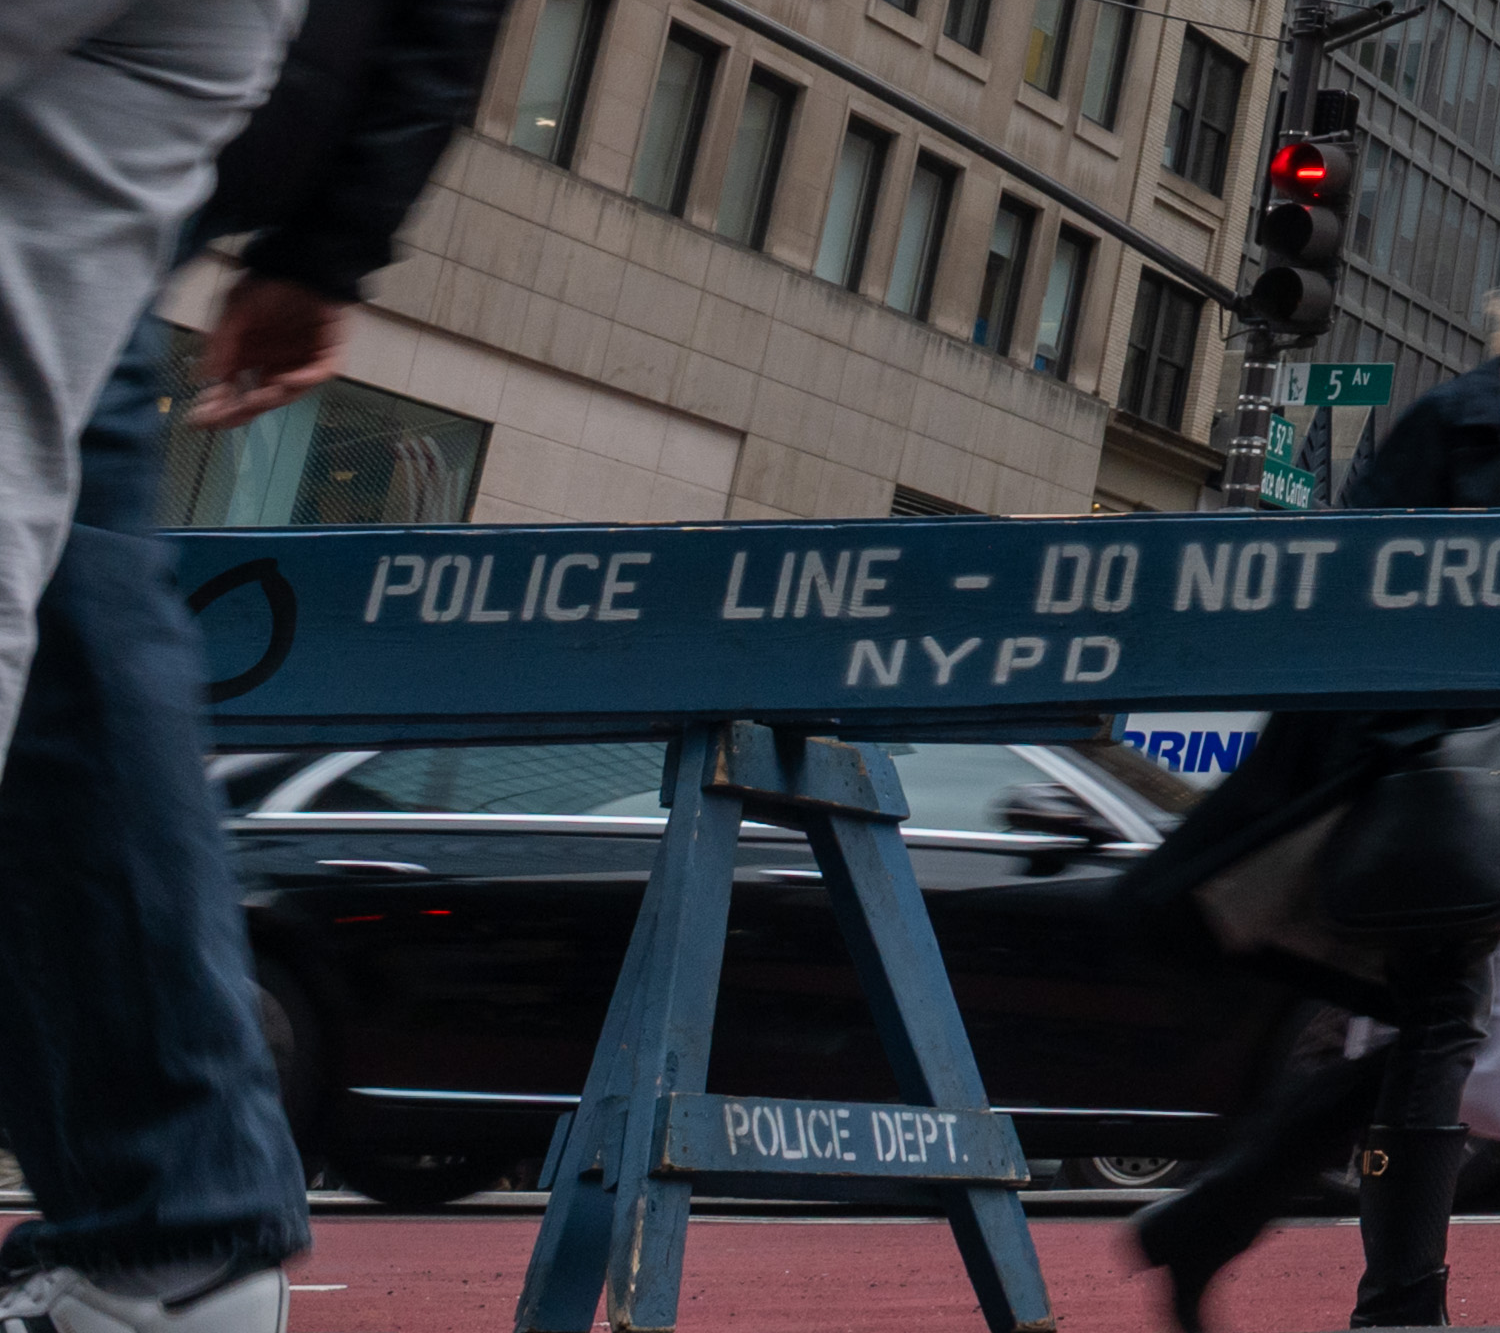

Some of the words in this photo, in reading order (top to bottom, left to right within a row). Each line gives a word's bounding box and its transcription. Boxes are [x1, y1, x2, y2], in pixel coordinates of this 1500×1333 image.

[1327, 370, 1343, 400] 5
[1351, 367, 1371, 386] Av
[1267, 420, 1276, 451] E
[1274, 423, 1287, 455] 52
[1260, 470, 1273, 496] ace
[1274, 469, 1285, 501] de
[1285, 473, 1311, 509] Cartier
[364, 552, 652, 622] POLICE
[722, 549, 901, 620] LINE
[953, 576, 992, 589] -
[1035, 544, 1139, 614] DO
[1174, 541, 1337, 612] NOT
[845, 635, 1121, 687] NYPD
[724, 1103, 856, 1161] POLICE
[872, 1111, 969, 1164] DEPT.
